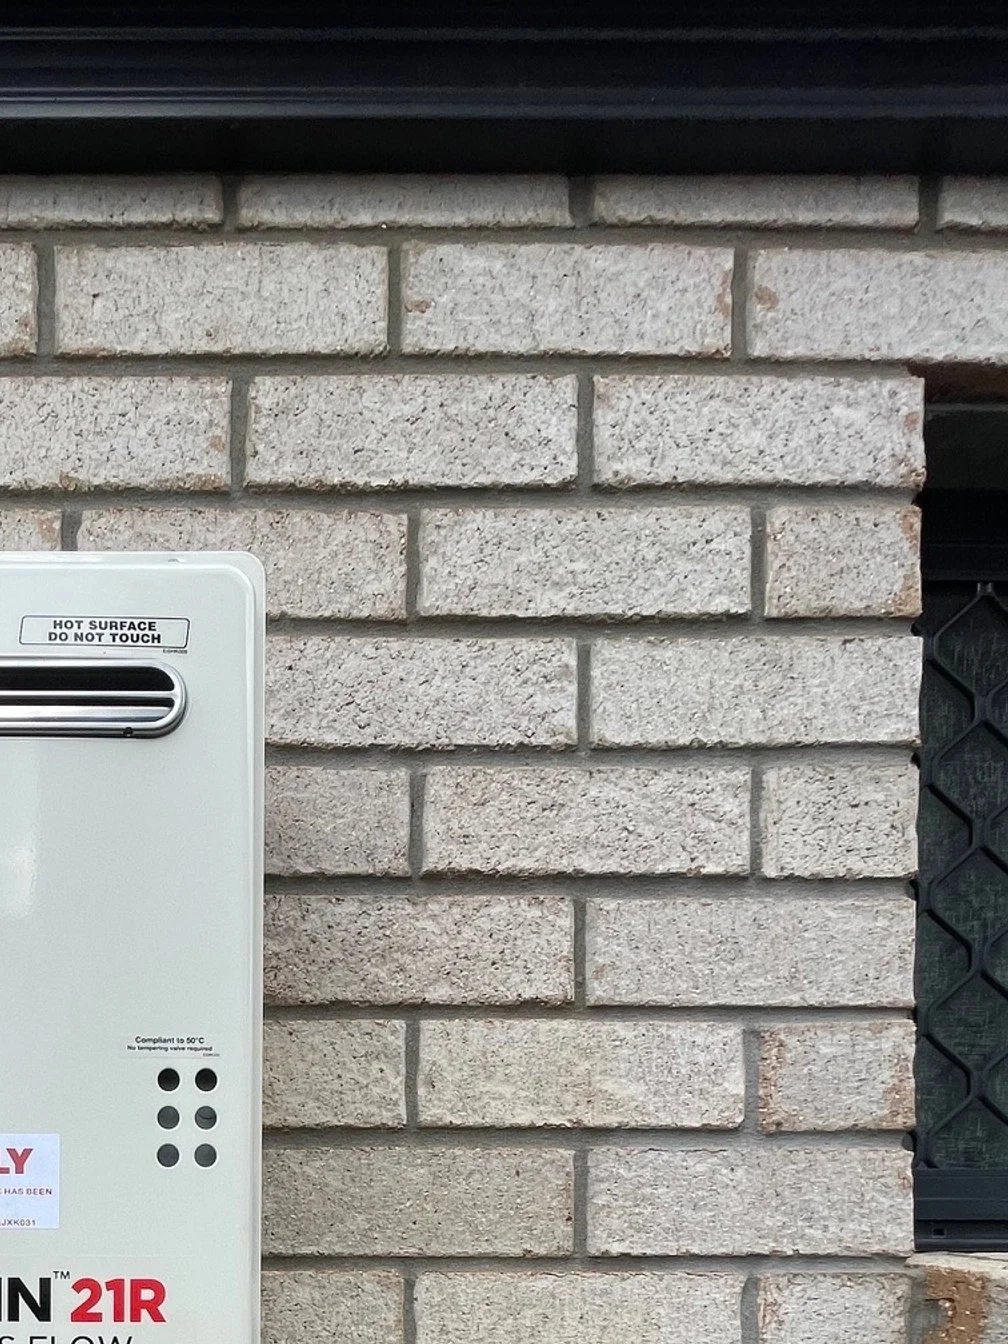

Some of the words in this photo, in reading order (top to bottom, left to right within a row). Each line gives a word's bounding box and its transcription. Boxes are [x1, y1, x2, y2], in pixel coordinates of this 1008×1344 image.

[53, 619, 84, 630] HOT
[89, 620, 157, 631] SURFACE
[48, 631, 69, 642] DO
[73, 632, 105, 642] NOT
[110, 633, 162, 644] TOUCH
[135, 1036, 175, 1045] Compliant
[70, 1278, 167, 1323] 21R
